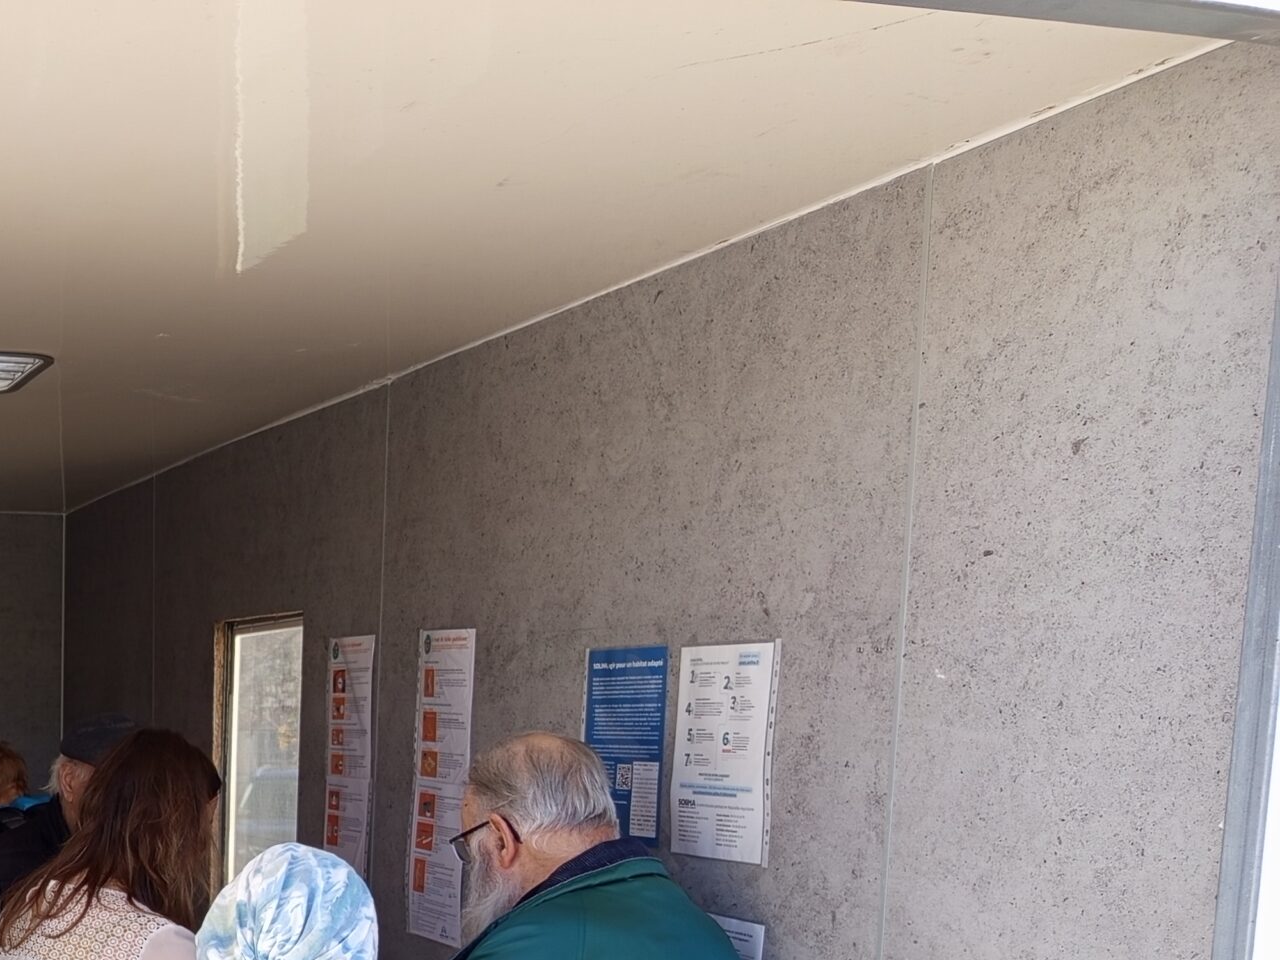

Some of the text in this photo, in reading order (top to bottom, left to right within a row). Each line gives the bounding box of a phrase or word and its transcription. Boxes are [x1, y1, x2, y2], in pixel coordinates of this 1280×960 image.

[689, 669, 696, 683] 1
[723, 675, 731, 690] 2
[685, 702, 692, 716] 4
[730, 695, 737, 710] 3
[686, 728, 693, 742] 5
[722, 732, 730, 746] 6
[684, 753, 691, 767] 7
